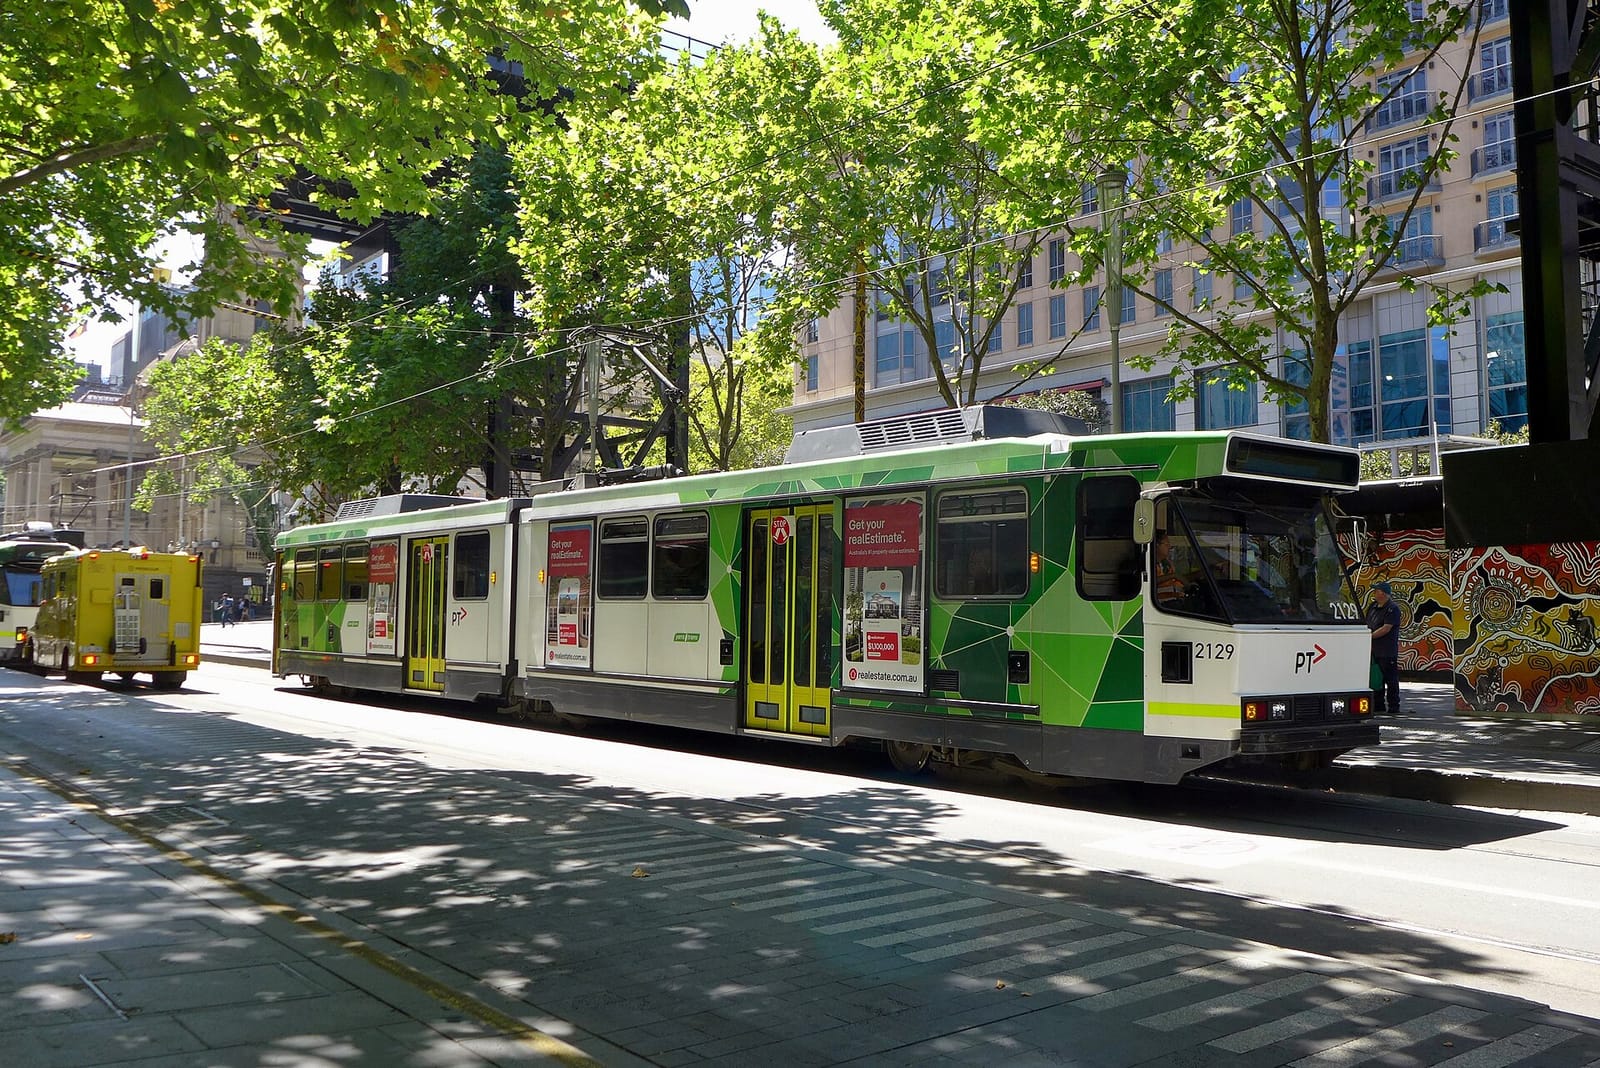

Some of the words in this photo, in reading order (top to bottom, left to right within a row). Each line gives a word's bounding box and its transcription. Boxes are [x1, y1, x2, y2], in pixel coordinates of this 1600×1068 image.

[773, 519, 787, 528] STOP
[848, 519, 864, 530] Get
[866, 520, 885, 532] your
[551, 540, 561, 549] Get
[1329, 602, 1359, 620] 2129
[1195, 642, 1235, 660] 2129
[857, 670, 918, 683] realestate.com.au
